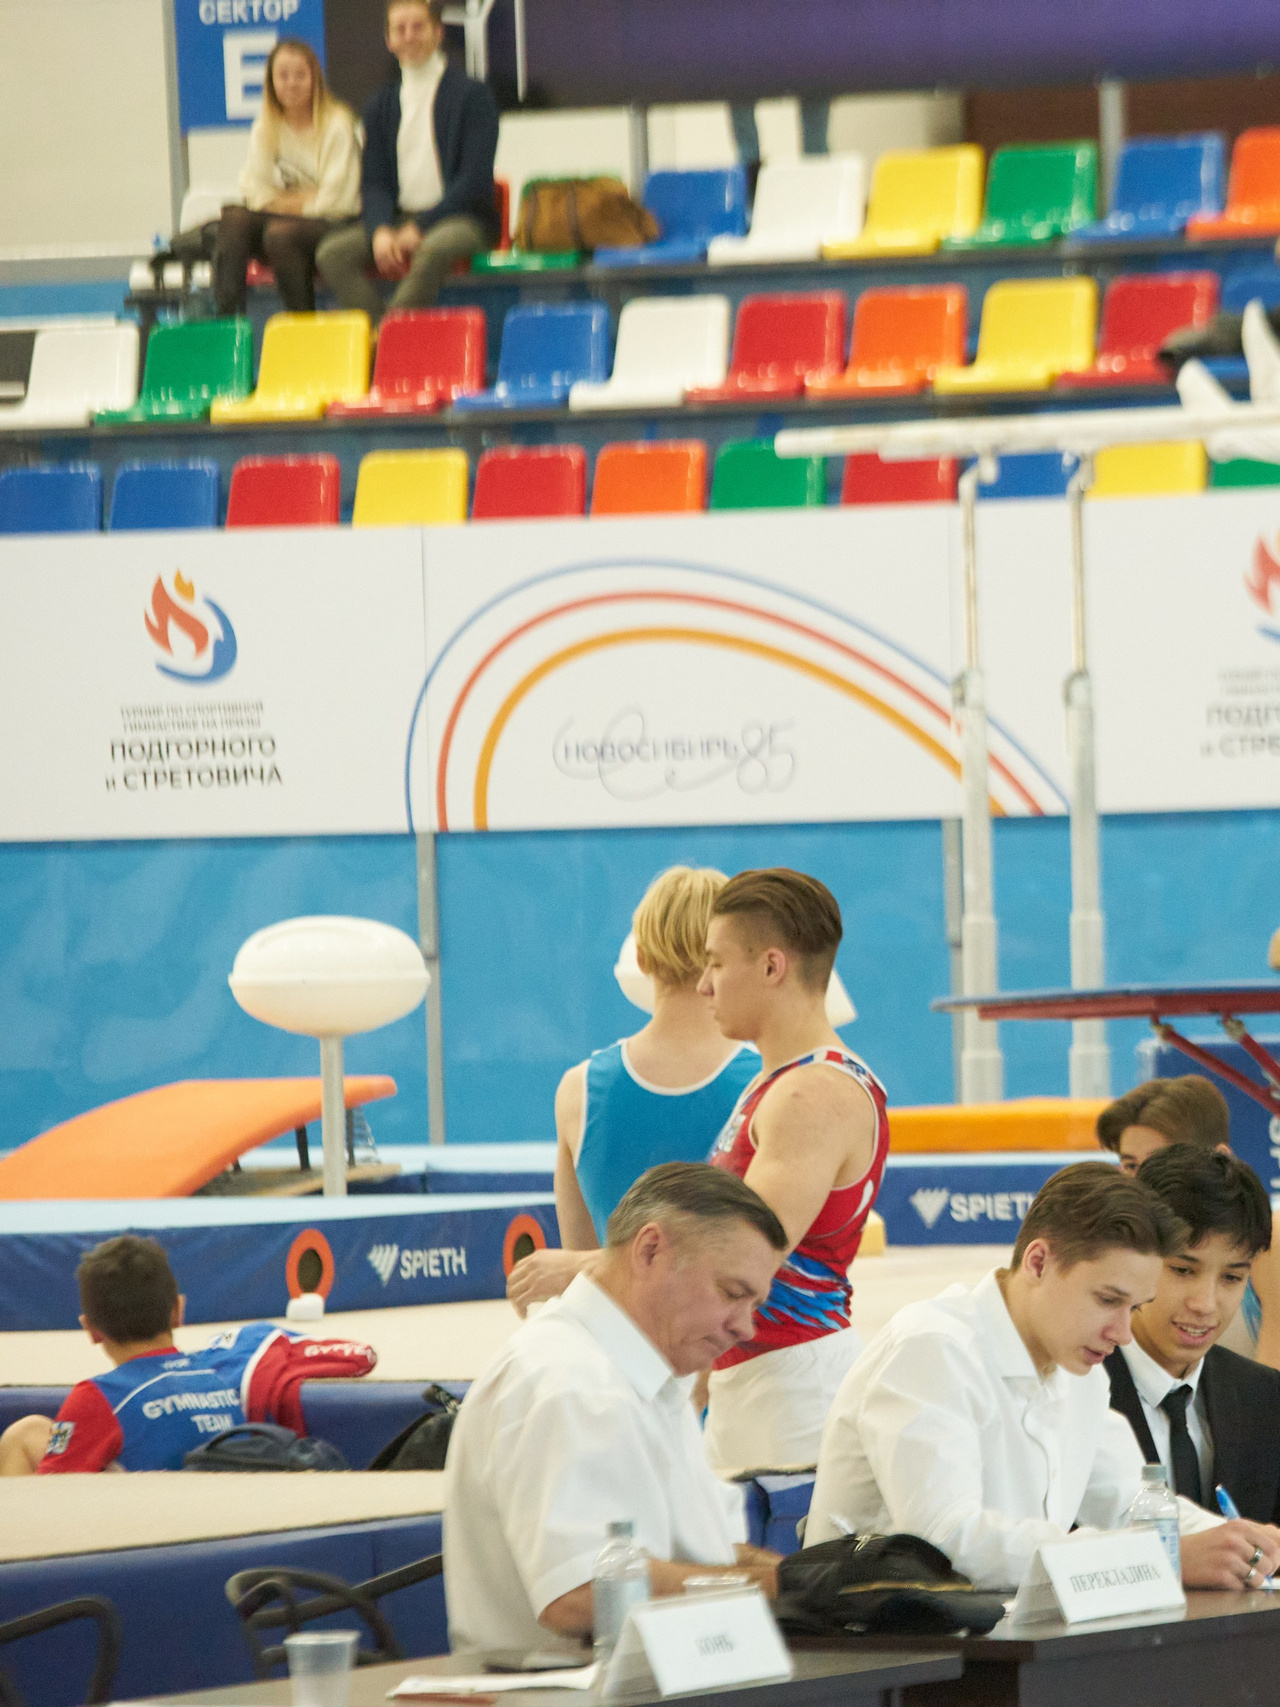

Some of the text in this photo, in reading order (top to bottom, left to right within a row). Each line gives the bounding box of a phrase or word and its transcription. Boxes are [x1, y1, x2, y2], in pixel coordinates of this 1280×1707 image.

[199, 0, 300, 25] СЕКТОР
[110, 735, 277, 764] ПОДГОРНОГО
[123, 762, 283, 791] СТРЕТОВИЧА
[949, 1191, 1034, 1222] SPIET
[400, 1246, 467, 1280] SPIETH
[142, 1388, 241, 1420] GYMNASTIC
[190, 1413, 234, 1434] TEAM
[1068, 1564, 1161, 1594] ПЕРЕКЛАДИНА
